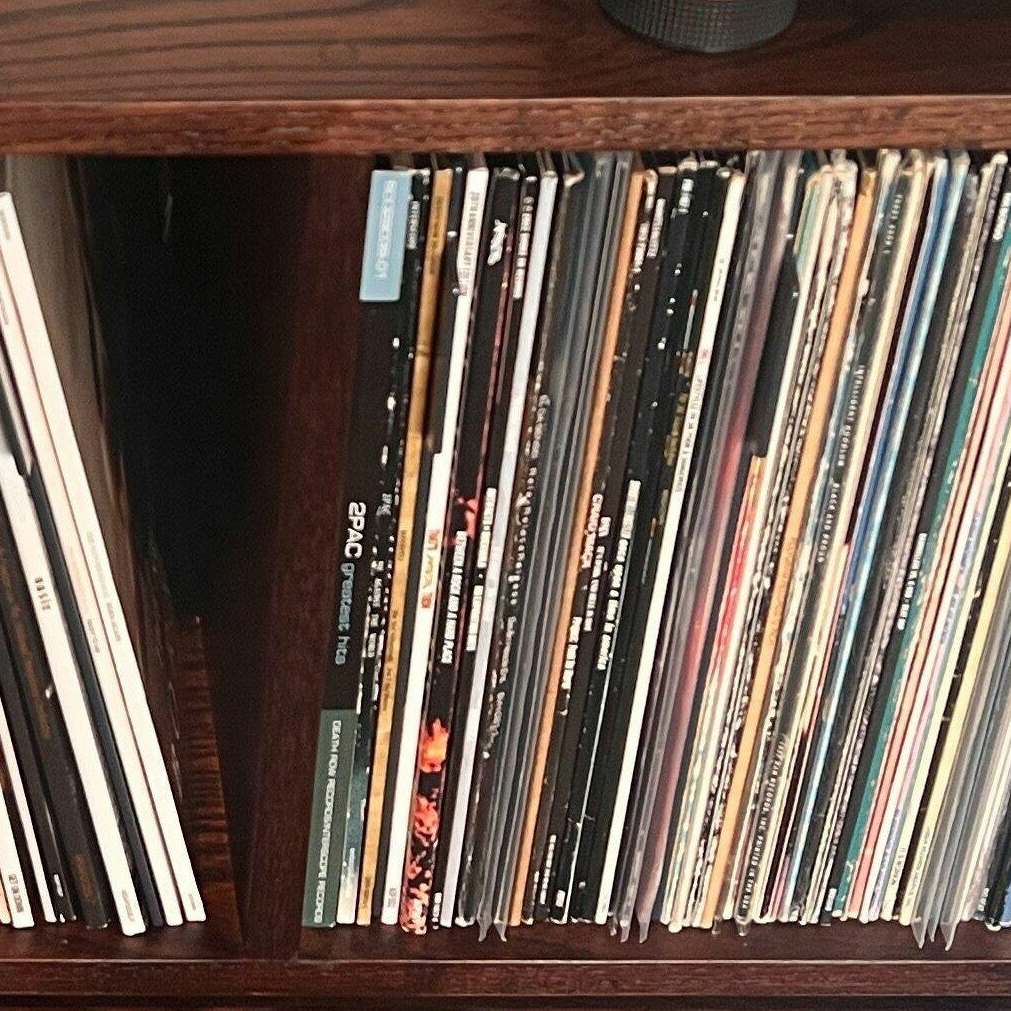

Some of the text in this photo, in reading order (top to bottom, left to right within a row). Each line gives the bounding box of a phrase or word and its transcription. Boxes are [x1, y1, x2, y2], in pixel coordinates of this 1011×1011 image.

[334, 499, 367, 665] 2PAC greatest hits
[329, 719, 341, 754] DEATH
[326, 753, 338, 777] ROW
[313, 879, 326, 924] RECORDS
